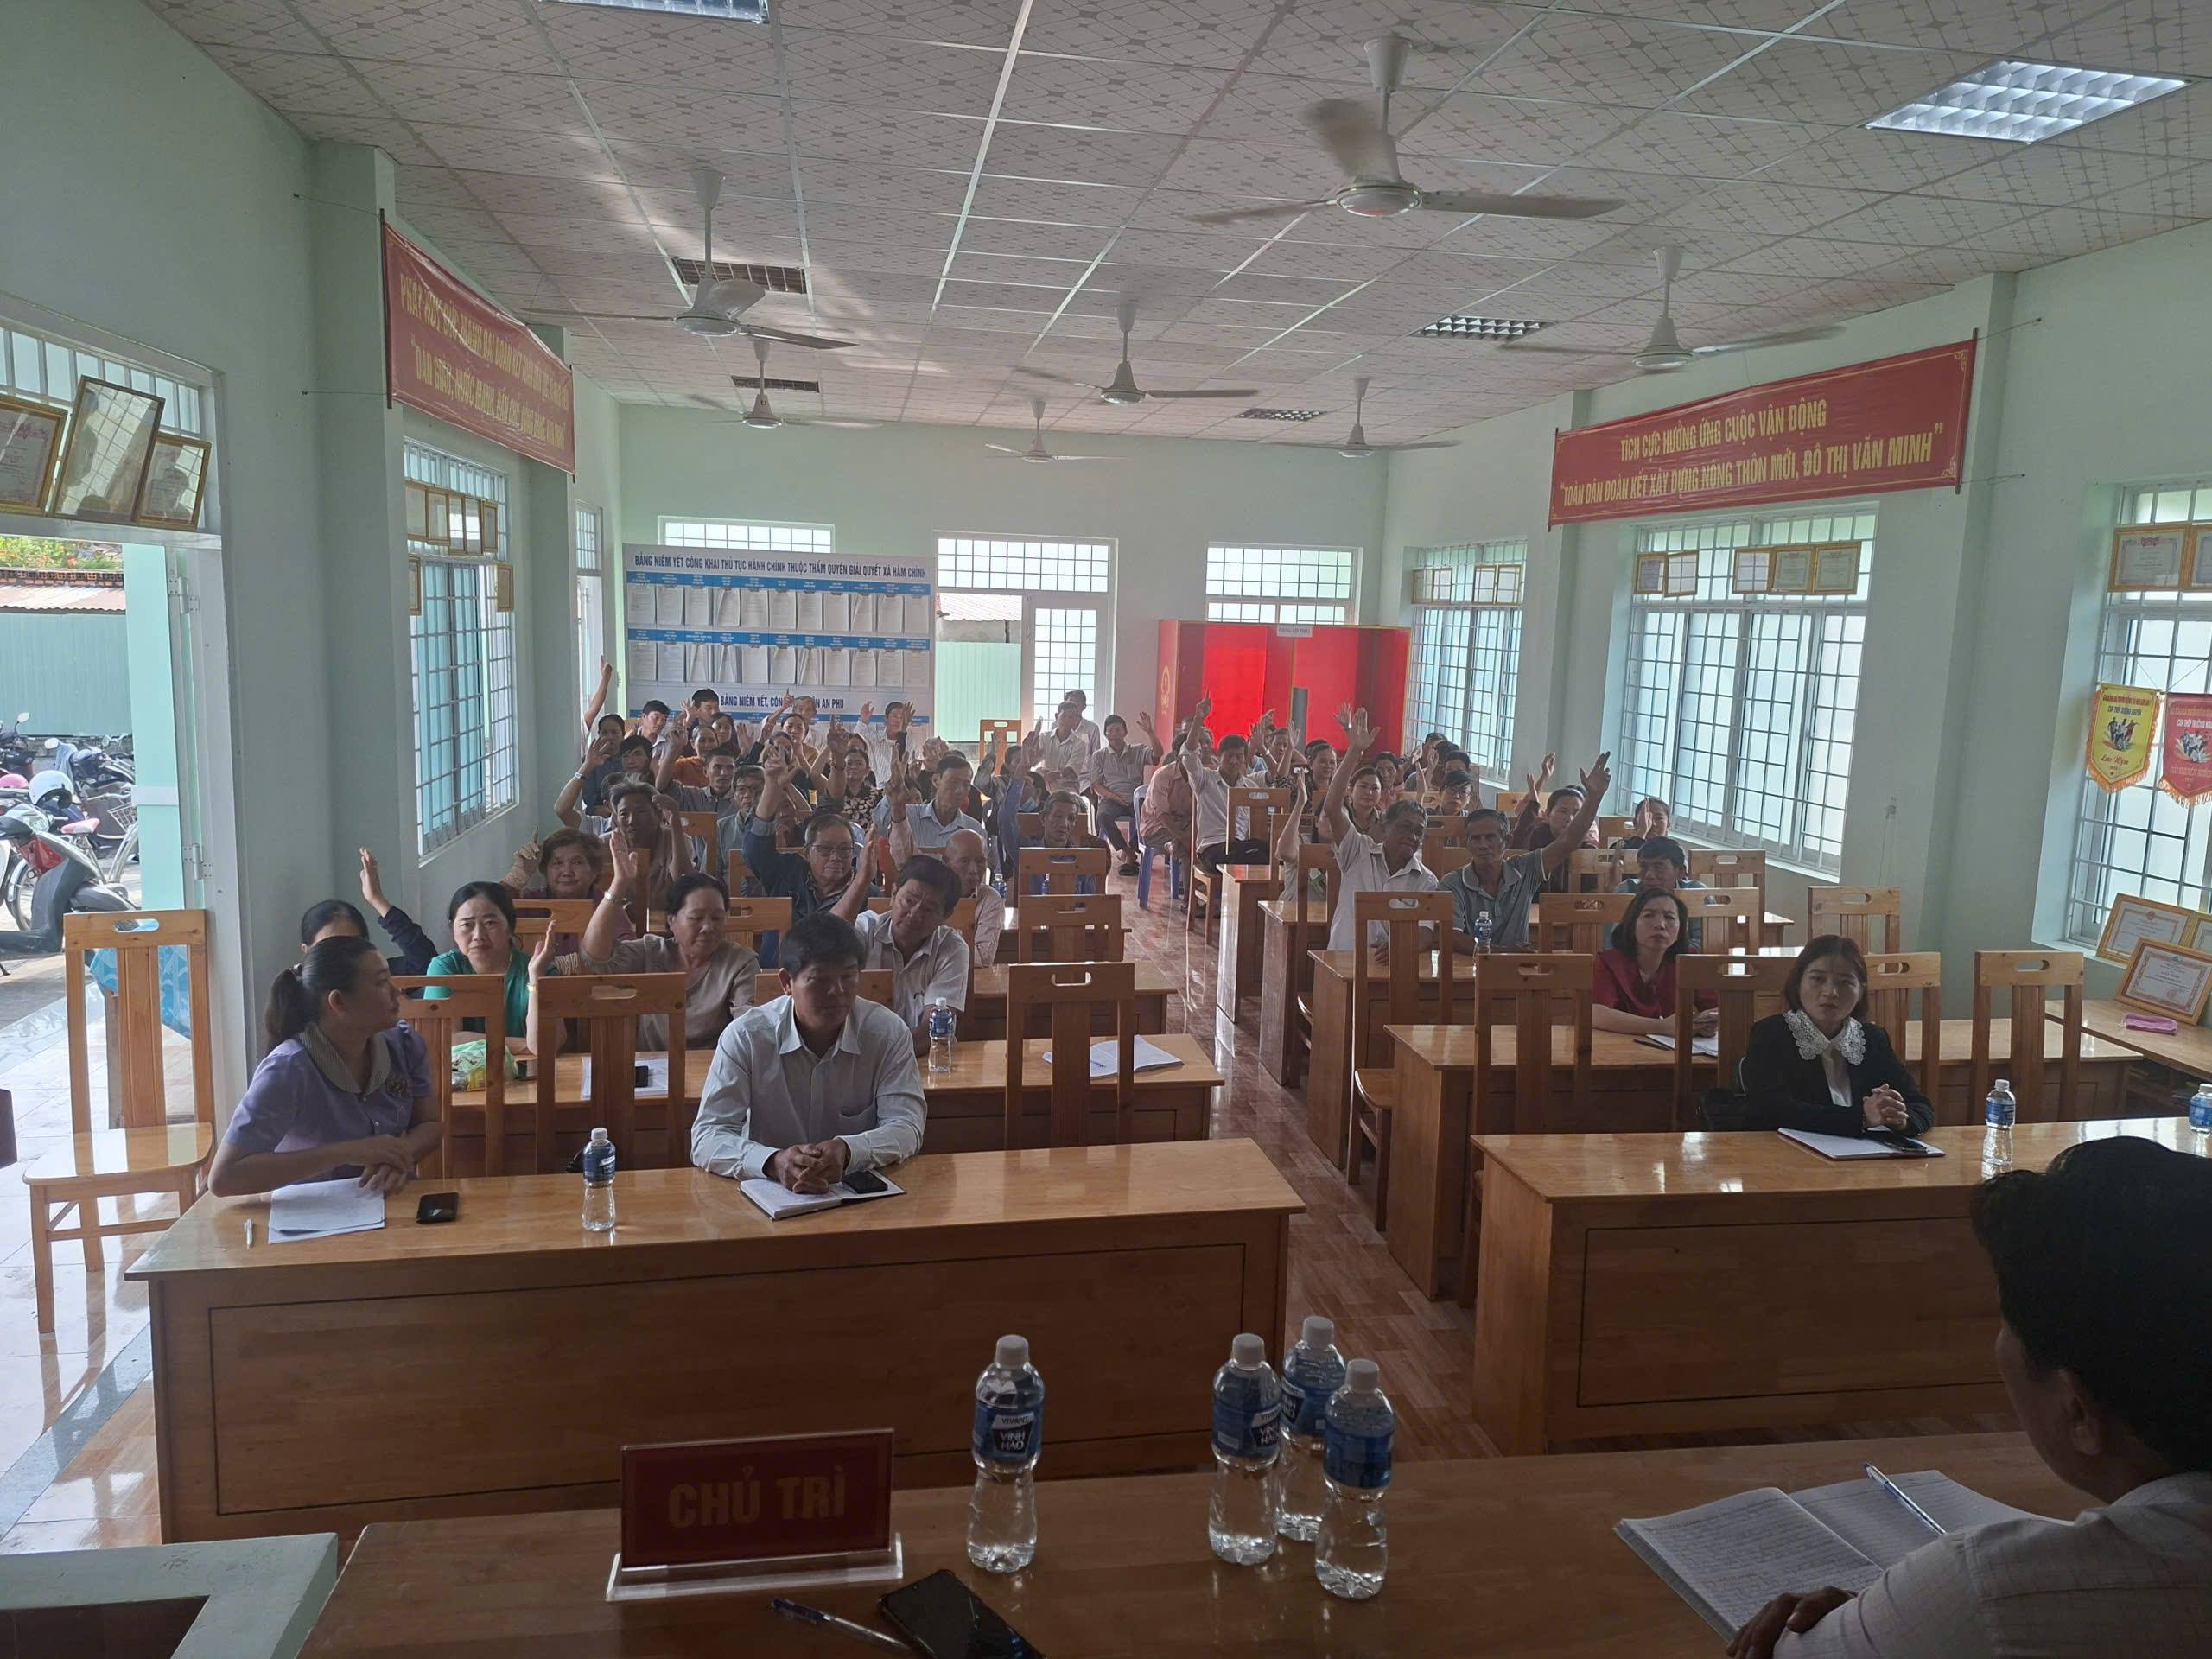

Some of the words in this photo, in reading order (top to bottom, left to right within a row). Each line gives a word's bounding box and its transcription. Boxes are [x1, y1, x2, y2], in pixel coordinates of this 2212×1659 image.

[1621, 434, 1640, 461] TÍCH
[1642, 431, 1661, 462] CỰC
[1662, 420, 1697, 454] HƯỞNG
[1699, 417, 1721, 448] ỨNG
[1725, 408, 1756, 446] CUỘC
[1759, 404, 1784, 442] VẬN
[1789, 397, 1827, 436] ĐỘNG
[1586, 478, 1603, 504] DÂN
[1605, 473, 1628, 501] ĐOÀN
[1630, 467, 1648, 499] KẾT
[1649, 467, 1669, 498] XÂY
[1671, 467, 1699, 499] DỰNG
[1701, 460, 1732, 489] NÔNG
[1736, 452, 1767, 485] THÔN
[1771, 448, 1799, 481] MỚI,
[1803, 442, 1821, 477] ĐÔ
[1827, 444, 1848, 479] THỊ
[1853, 435, 1884, 471] VĂN
[672, 554, 683, 568] YẾT
[685, 556, 703, 569] CÔNG
[704, 557, 720, 569] KHAI
[721, 556, 734, 570] THỦ
[734, 559, 747, 573] TỤC
[766, 559, 786, 573] CHÍNH
[787, 560, 807, 575] THUỘC
[849, 563, 861, 576] GIẢI
[863, 563, 882, 578] QUYẾT
[720, 693, 737, 706] BẢNG
[739, 694, 755, 707] NIÊM
[822, 698, 830, 709] AN
[832, 696, 844, 709] PHÚ
[668, 1465, 761, 1529] CHỦ
[776, 1465, 847, 1520] TRÌ
